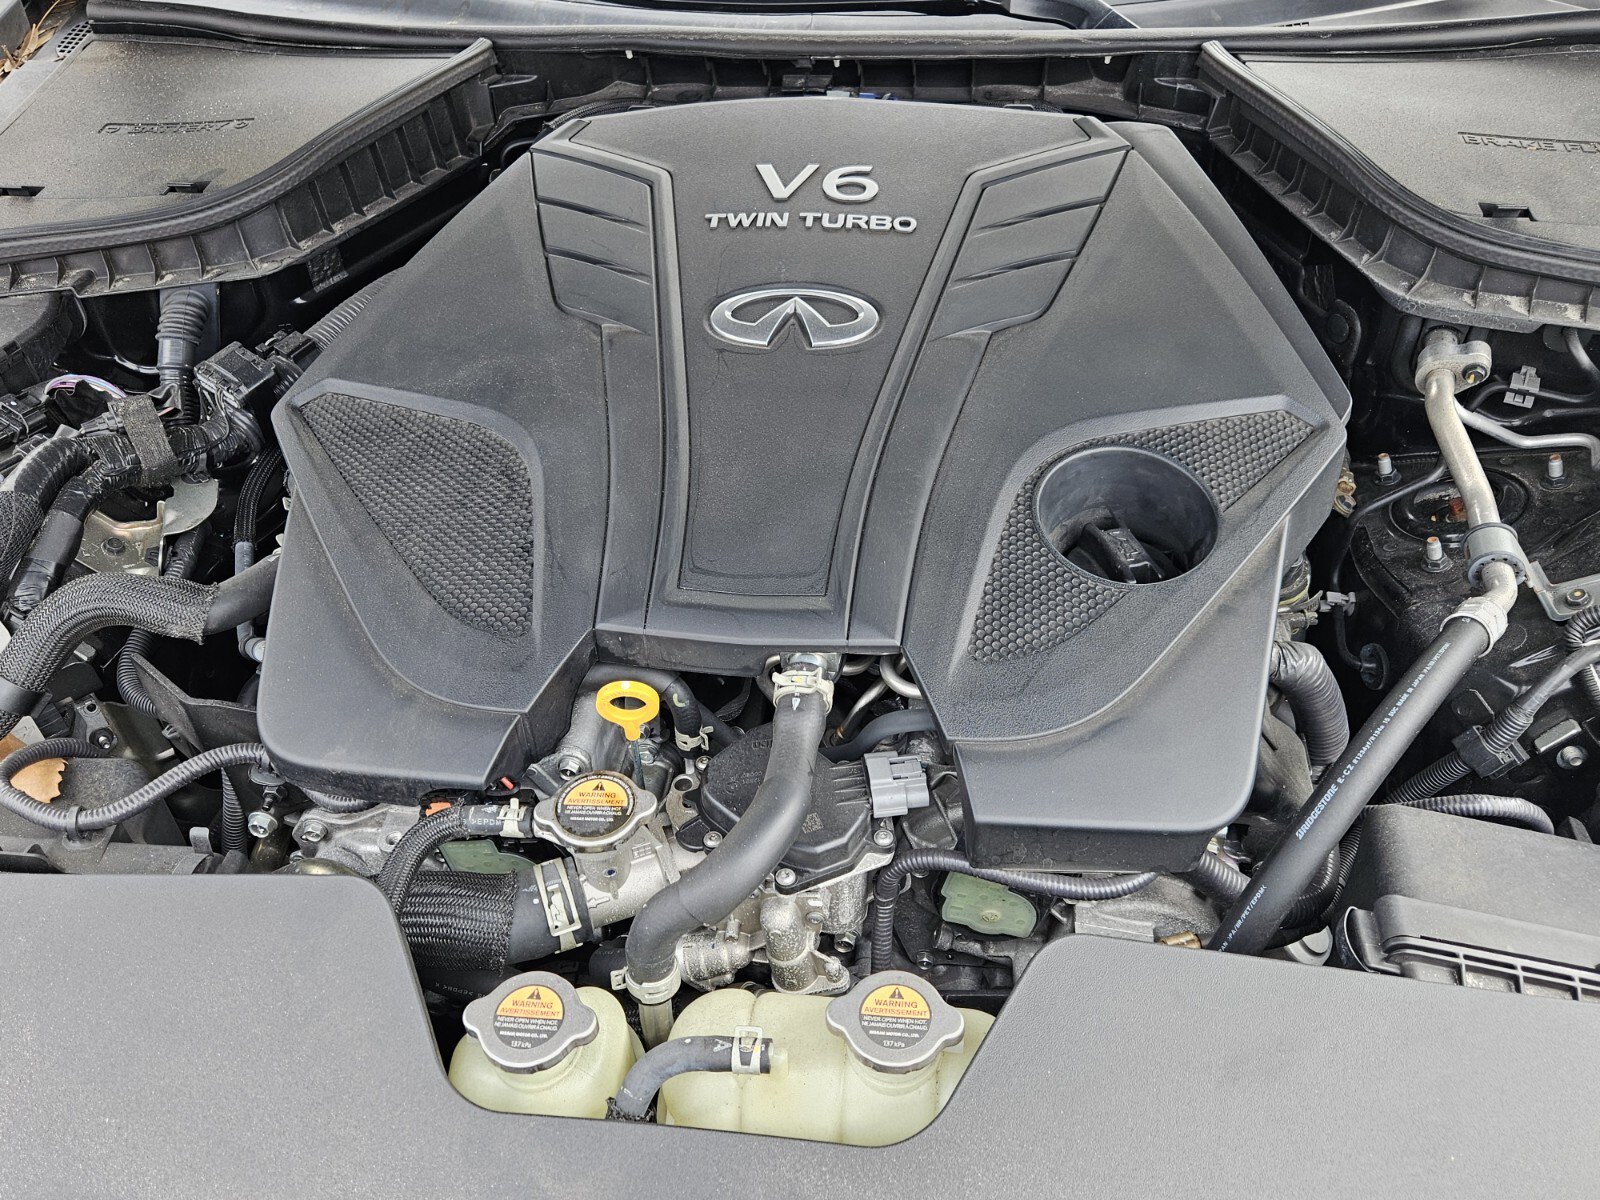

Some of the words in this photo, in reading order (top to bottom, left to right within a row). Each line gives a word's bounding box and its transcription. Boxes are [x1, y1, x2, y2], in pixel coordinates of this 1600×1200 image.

[1461, 135, 1558, 152] BRAKE
[755, 163, 879, 204] V6
[704, 212, 790, 229] TWIN
[799, 212, 918, 234] TURBO
[578, 791, 617, 799] WARNING
[567, 798, 625, 806] AVERTISSEMENT
[1295, 783, 1339, 841] BRIDGESTONE
[512, 999, 554, 1010] WARNING
[874, 998, 918, 1009] WARNING
[499, 1008, 560, 1018] AVERTISSEMENT
[864, 1006, 928, 1017] AVERTISSEMENT
